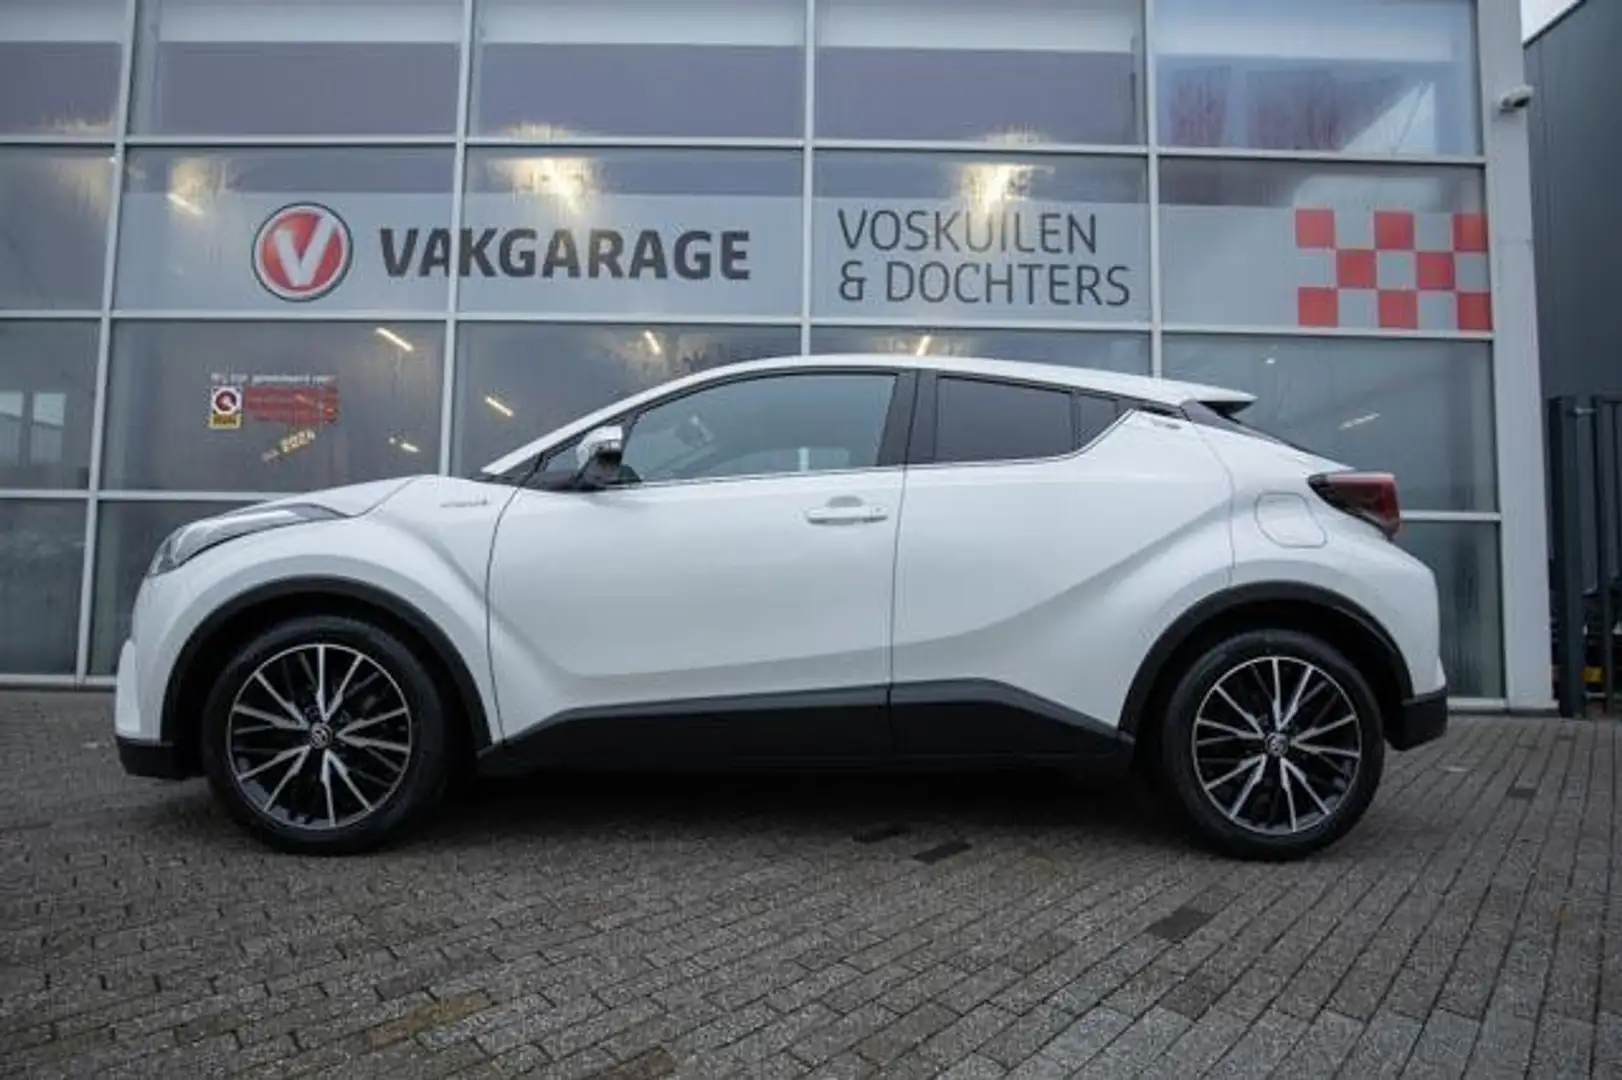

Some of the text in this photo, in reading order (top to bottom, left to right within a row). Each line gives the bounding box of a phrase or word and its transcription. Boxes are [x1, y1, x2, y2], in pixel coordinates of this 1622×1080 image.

[273, 212, 337, 287] V
[381, 227, 751, 280] VAKGARAGE
[837, 209, 1097, 254] VOSKUILEN
[838, 259, 1131, 306] & DOCHTERS
